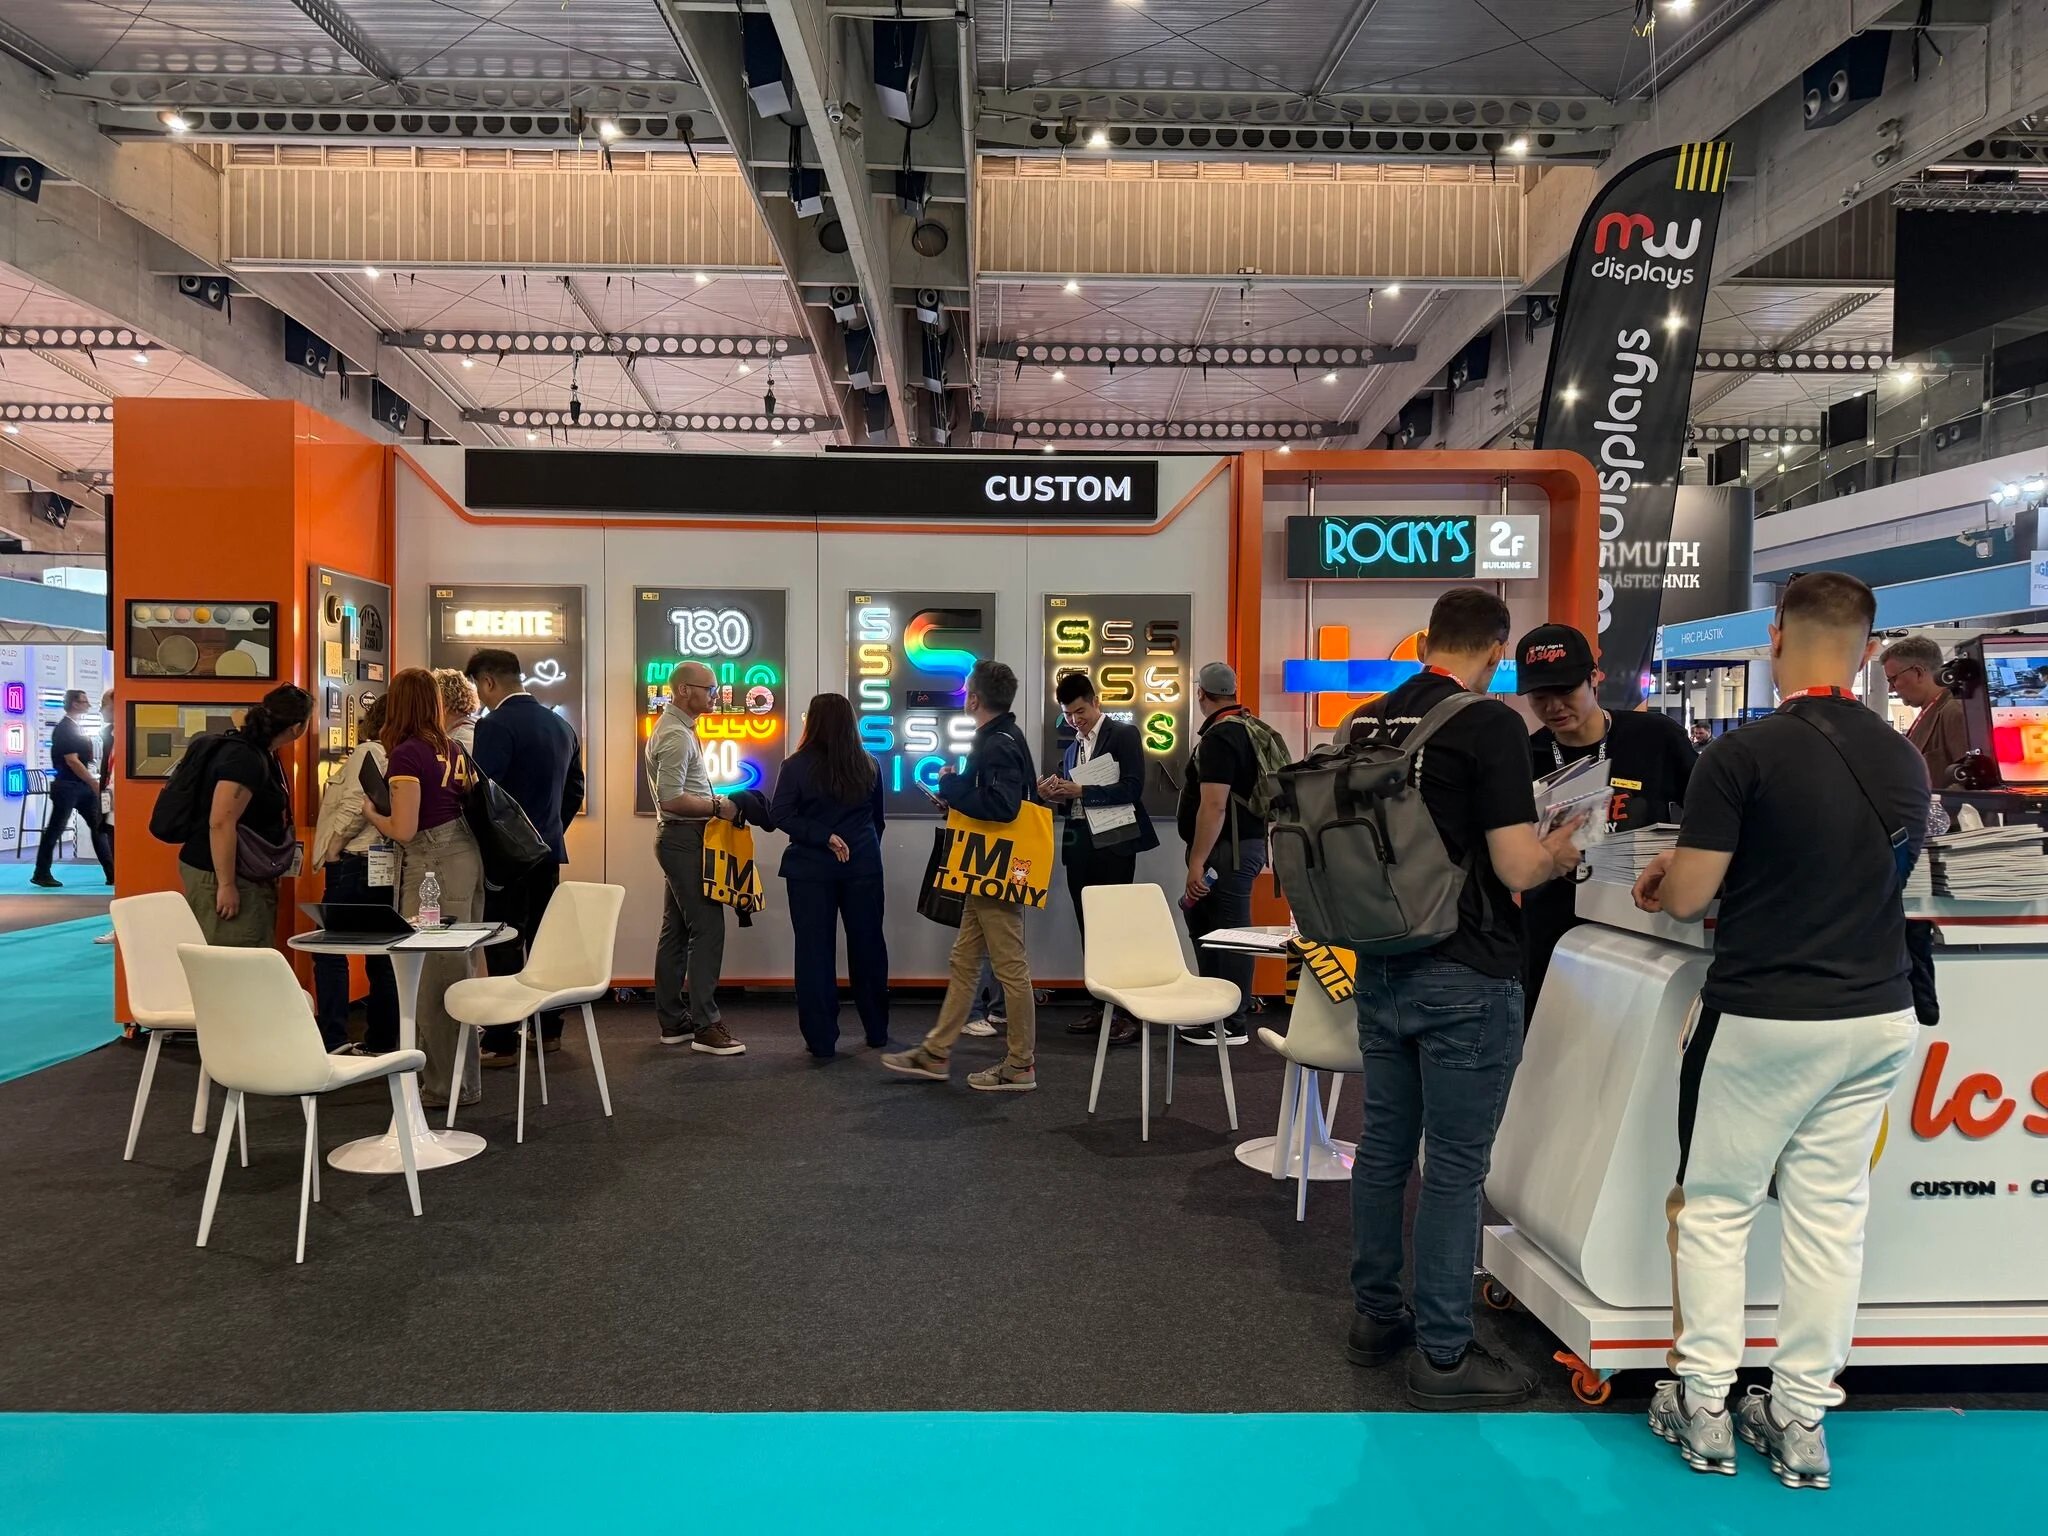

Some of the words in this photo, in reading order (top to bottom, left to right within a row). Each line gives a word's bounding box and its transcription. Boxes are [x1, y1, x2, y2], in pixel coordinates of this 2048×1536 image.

[1591, 256, 1694, 290] displays
[985, 475, 1131, 502] CUSTOM
[1325, 521, 1469, 564] ROCKY'S
[1482, 561, 1521, 569] BUILDING
[455, 610, 552, 636] CREATE
[670, 608, 752, 657] 180
[1681, 633, 1695, 645] HRC
[1696, 627, 1724, 642] PLASTIK
[942, 827, 1014, 881] I'M
[703, 847, 753, 894] I'M
[1910, 1180, 1996, 1197] CUSTOM
